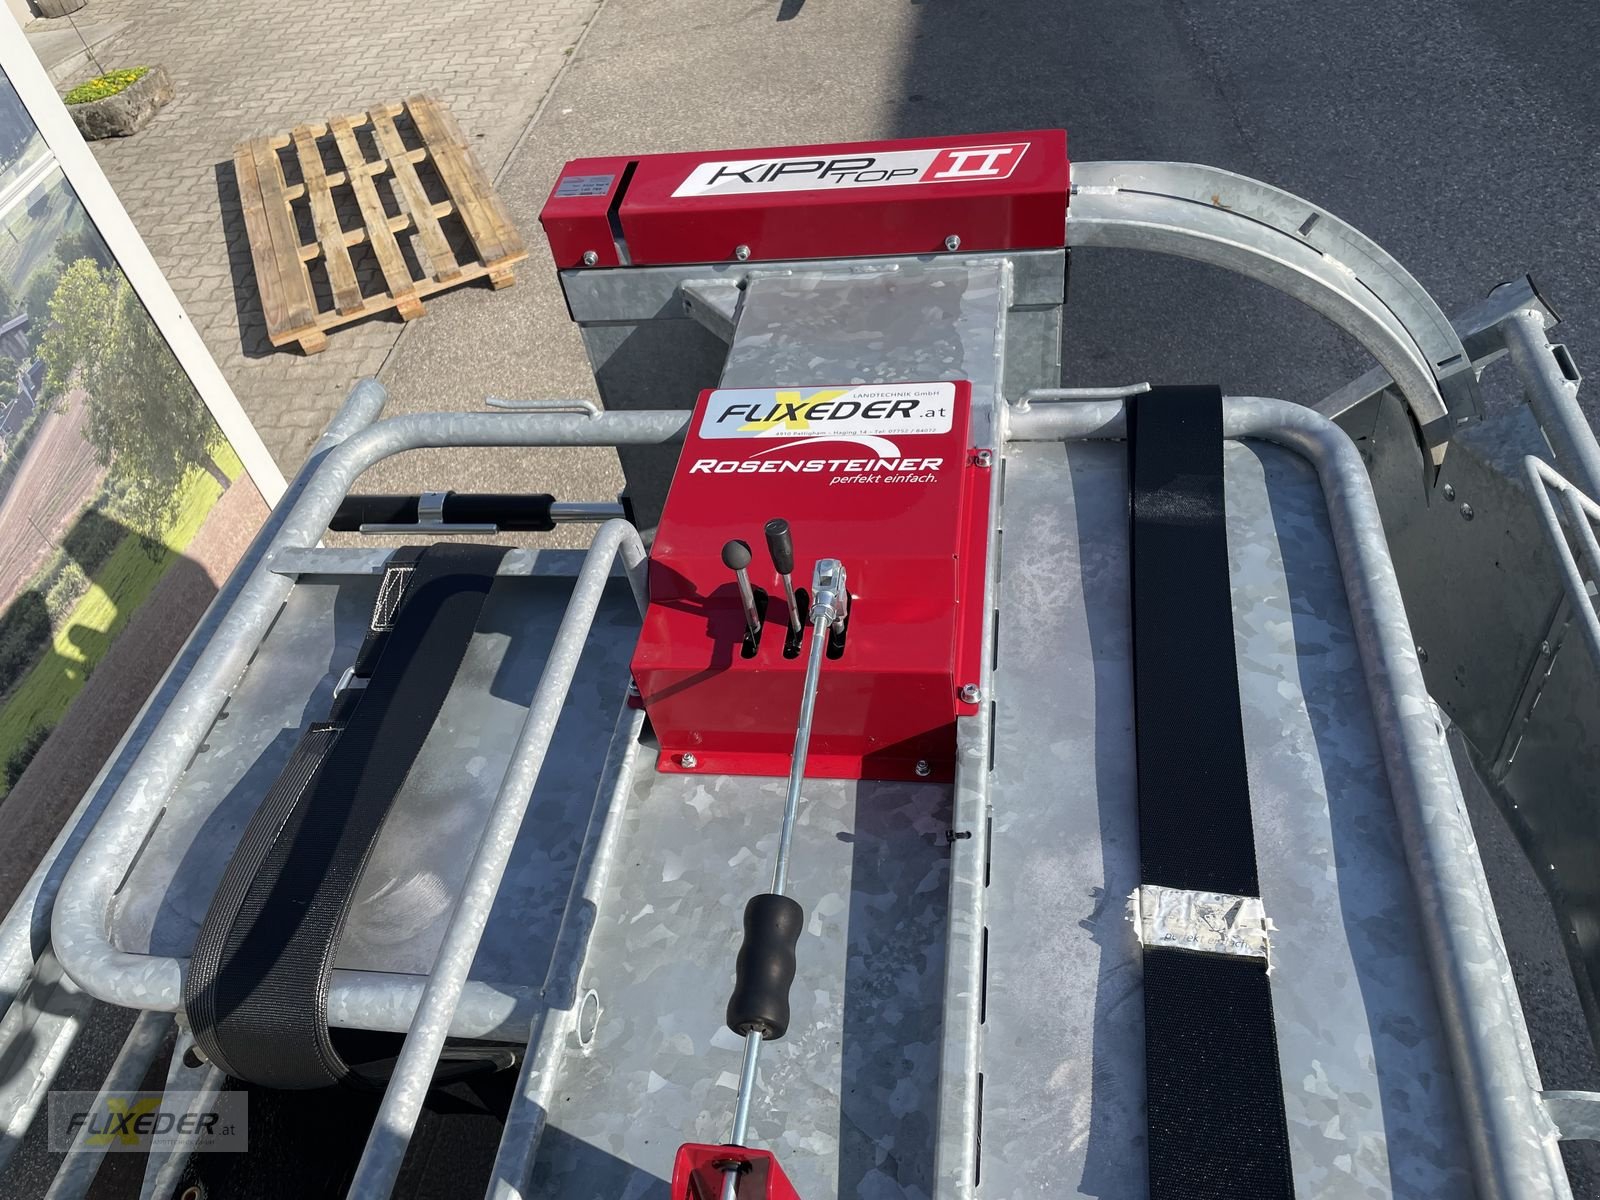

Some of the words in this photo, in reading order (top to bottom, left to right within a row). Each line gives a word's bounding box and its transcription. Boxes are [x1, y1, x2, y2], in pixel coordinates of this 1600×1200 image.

[707, 158, 876, 186] KIPP
[831, 168, 919, 184] TOP
[853, 391, 911, 399] LANDTECHNIK
[689, 458, 943, 474] ROSENSTEINER
[829, 473, 881, 485] perfekt
[884, 472, 938, 484] einfach.
